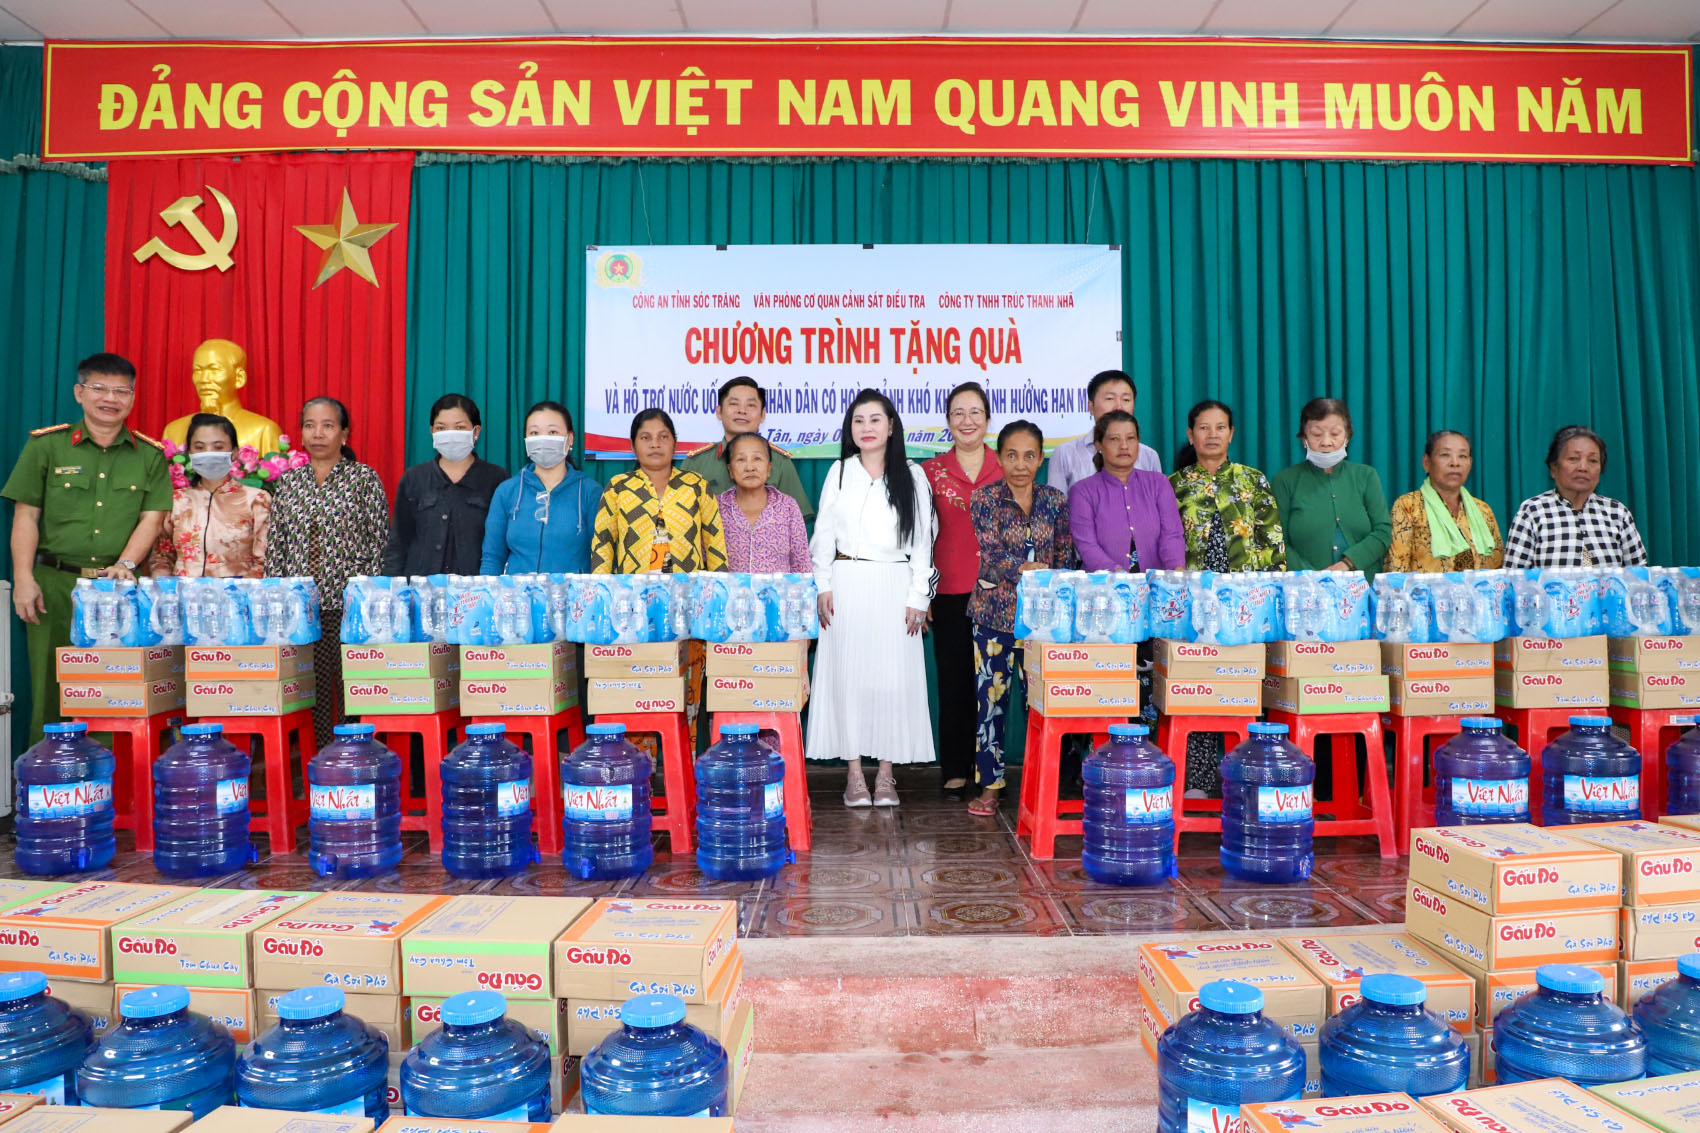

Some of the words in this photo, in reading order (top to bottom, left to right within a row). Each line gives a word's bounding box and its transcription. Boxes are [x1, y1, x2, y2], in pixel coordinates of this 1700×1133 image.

[99, 64, 262, 129] ĐẢNG
[284, 69, 448, 137] CỘNG
[468, 62, 590, 126] SẢN
[614, 67, 752, 135] VIỆT
[779, 80, 911, 125] NAM
[935, 79, 1139, 134] QUANG
[1159, 81, 1299, 127] VINH
[1324, 72, 1494, 131] MUÔN
[1518, 78, 1642, 133] NĂM
[633, 291, 655, 309] CÔNG
[658, 295, 668, 308] AN
[672, 290, 690, 308] TỈNH
[693, 291, 709, 308] SÓC
[774, 291, 801, 308] PHÒNG
[818, 295, 839, 310] QUAN
[843, 289, 865, 308] CẢNH
[868, 291, 883, 308] SÁT
[909, 294, 925, 308] TRA
[939, 292, 961, 308] CÔNG
[964, 294, 973, 308] TY
[977, 294, 999, 308] TNHH
[1002, 292, 1024, 308] TRÚC
[1027, 294, 1053, 308] THANH
[686, 320, 791, 364] CHƯƠNG
[801, 318, 880, 363] TRÌNH
[890, 320, 960, 374] TẶNG
[970, 318, 1021, 370] QUÀ
[605, 381, 620, 414] VÀ
[623, 376, 639, 414] HỖ
[669, 381, 699, 414] NƯỚC
[796, 382, 818, 414] DÂN
[822, 381, 837, 414] CÓ
[908, 381, 931, 414] KHÓ
[1011, 378, 1048, 414] HƯỞNG
[1052, 388, 1074, 419] HẠN
[797, 429, 829, 445] ngày
[907, 429, 935, 443] năm
[0, 930, 16, 945] ấu
